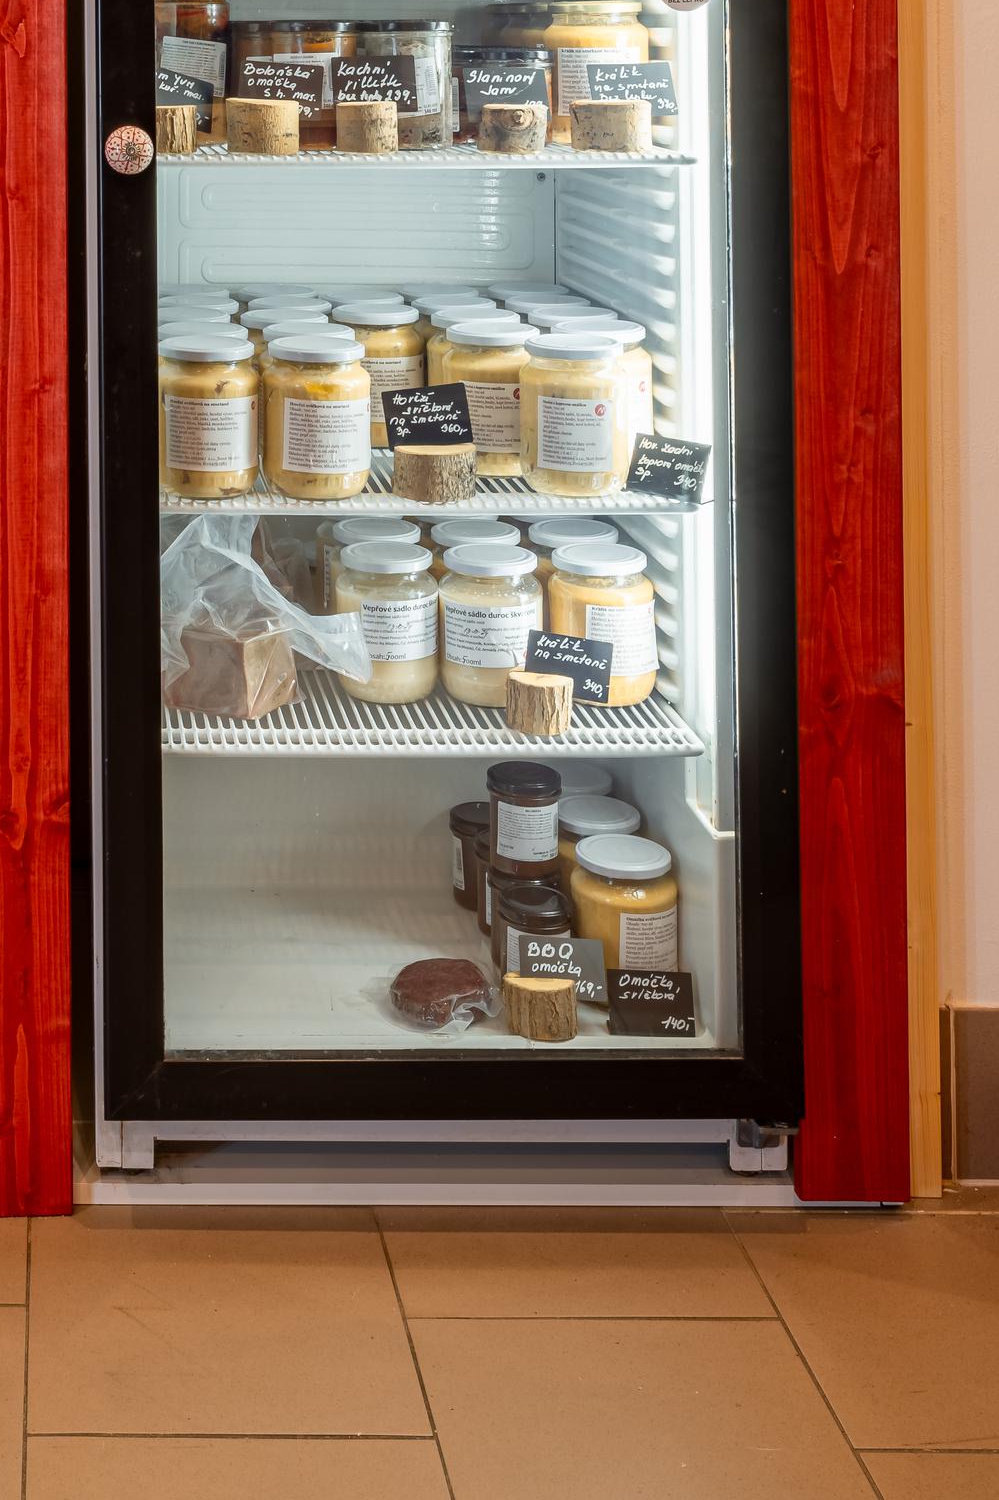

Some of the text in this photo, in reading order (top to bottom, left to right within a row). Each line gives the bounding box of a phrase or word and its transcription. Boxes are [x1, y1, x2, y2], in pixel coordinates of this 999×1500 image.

[594, 83, 614, 92] na
[390, 417, 406, 426] na
[440, 423, 469, 436] 360,-
[634, 466, 654, 482] 3p.
[362, 603, 392, 613] Vepřové
[393, 604, 412, 612] sádlo
[467, 609, 487, 619] sádlo
[487, 610, 509, 619] duroc
[536, 634, 584, 652] Králík
[534, 648, 608, 670] na smetaně
[582, 678, 610, 698] 340,-
[531, 961, 582, 977] omáčka
[618, 973, 674, 991] Omáčka
[660, 1016, 695, 1032] 140,-
